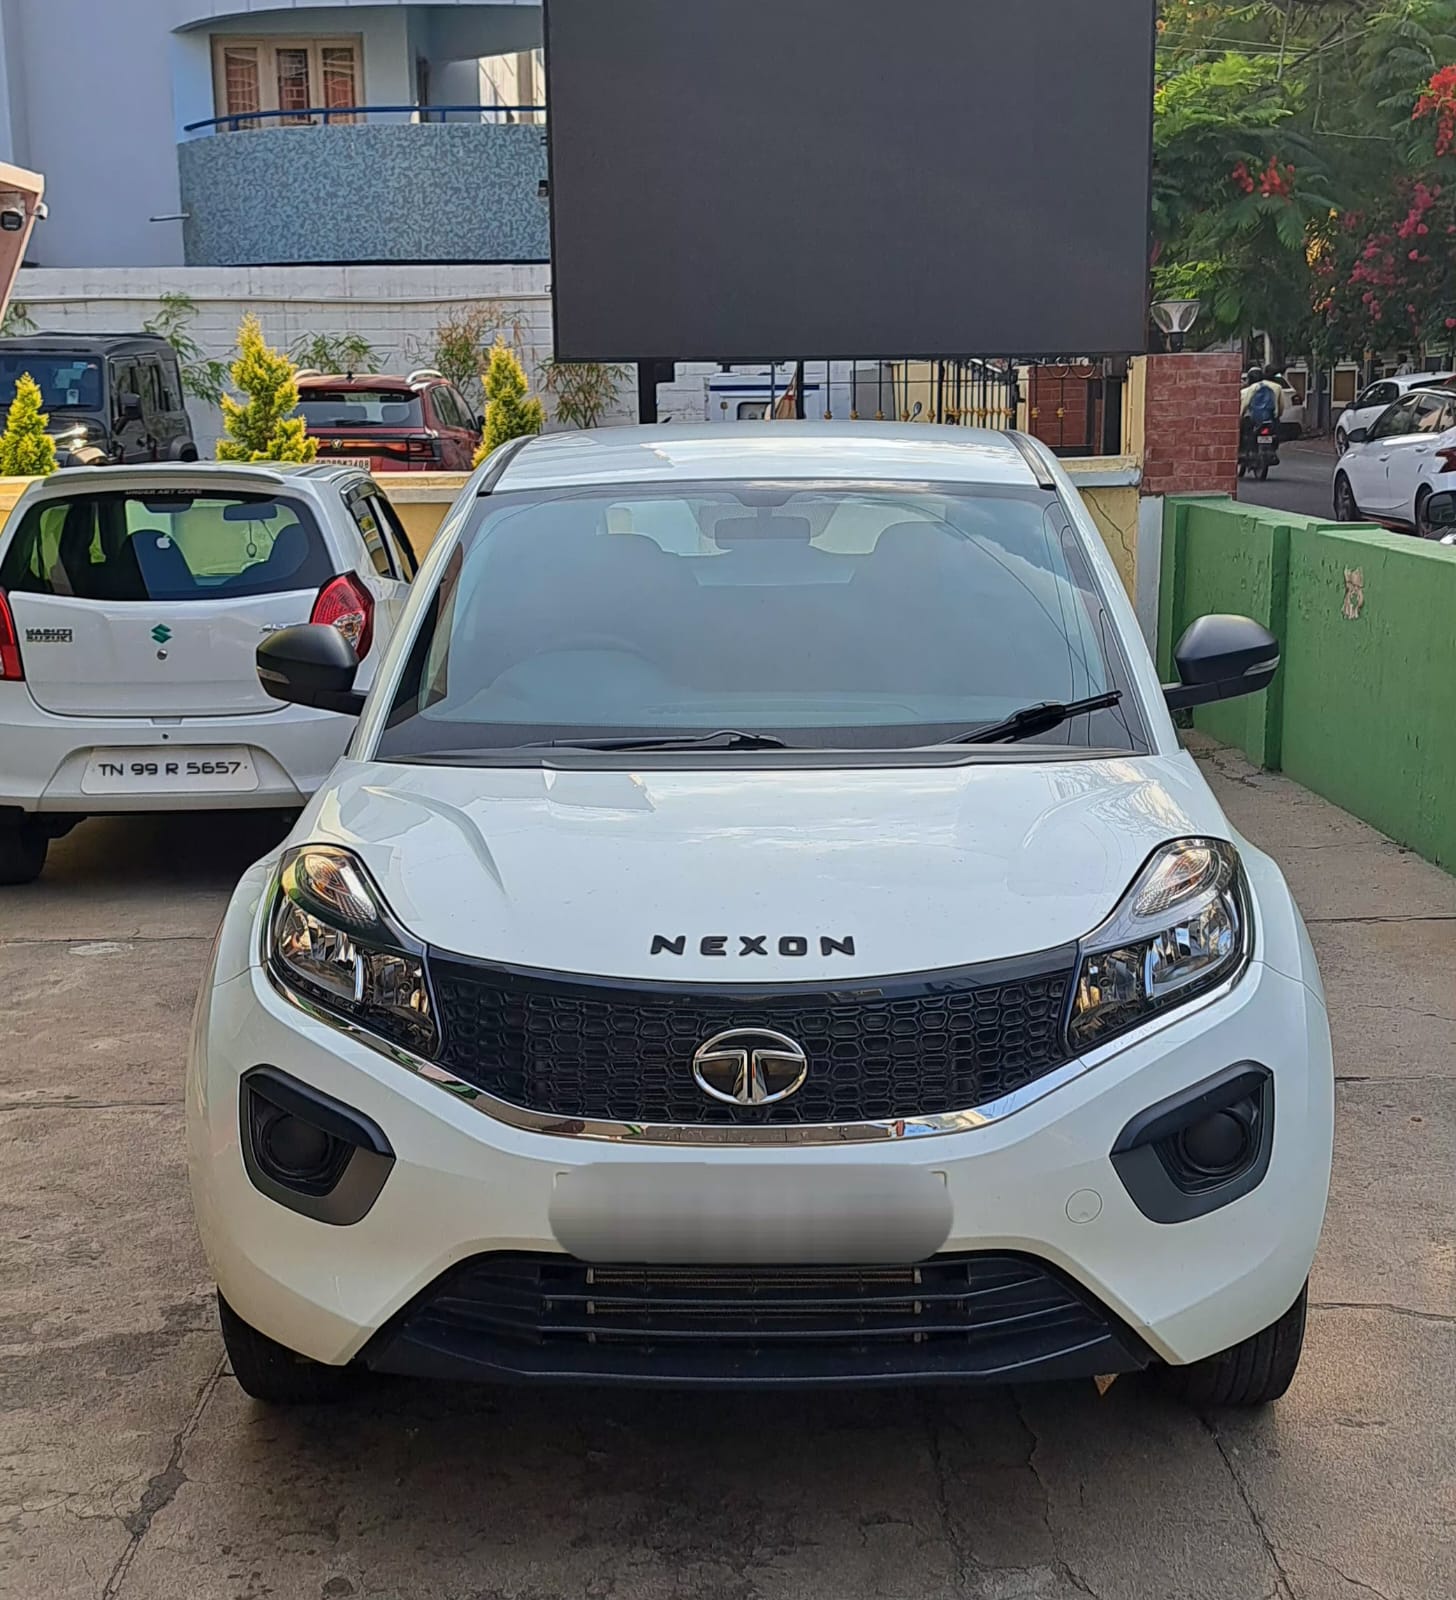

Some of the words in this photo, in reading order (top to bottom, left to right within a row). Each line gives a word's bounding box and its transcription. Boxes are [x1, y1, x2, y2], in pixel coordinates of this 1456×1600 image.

[25, 634, 73, 643] SUZUKI
[98, 763, 124, 776] TN
[130, 763, 158, 776] 99
[165, 763, 179, 775] R
[186, 761, 242, 775] 5657
[650, 934, 856, 957] NEXON
